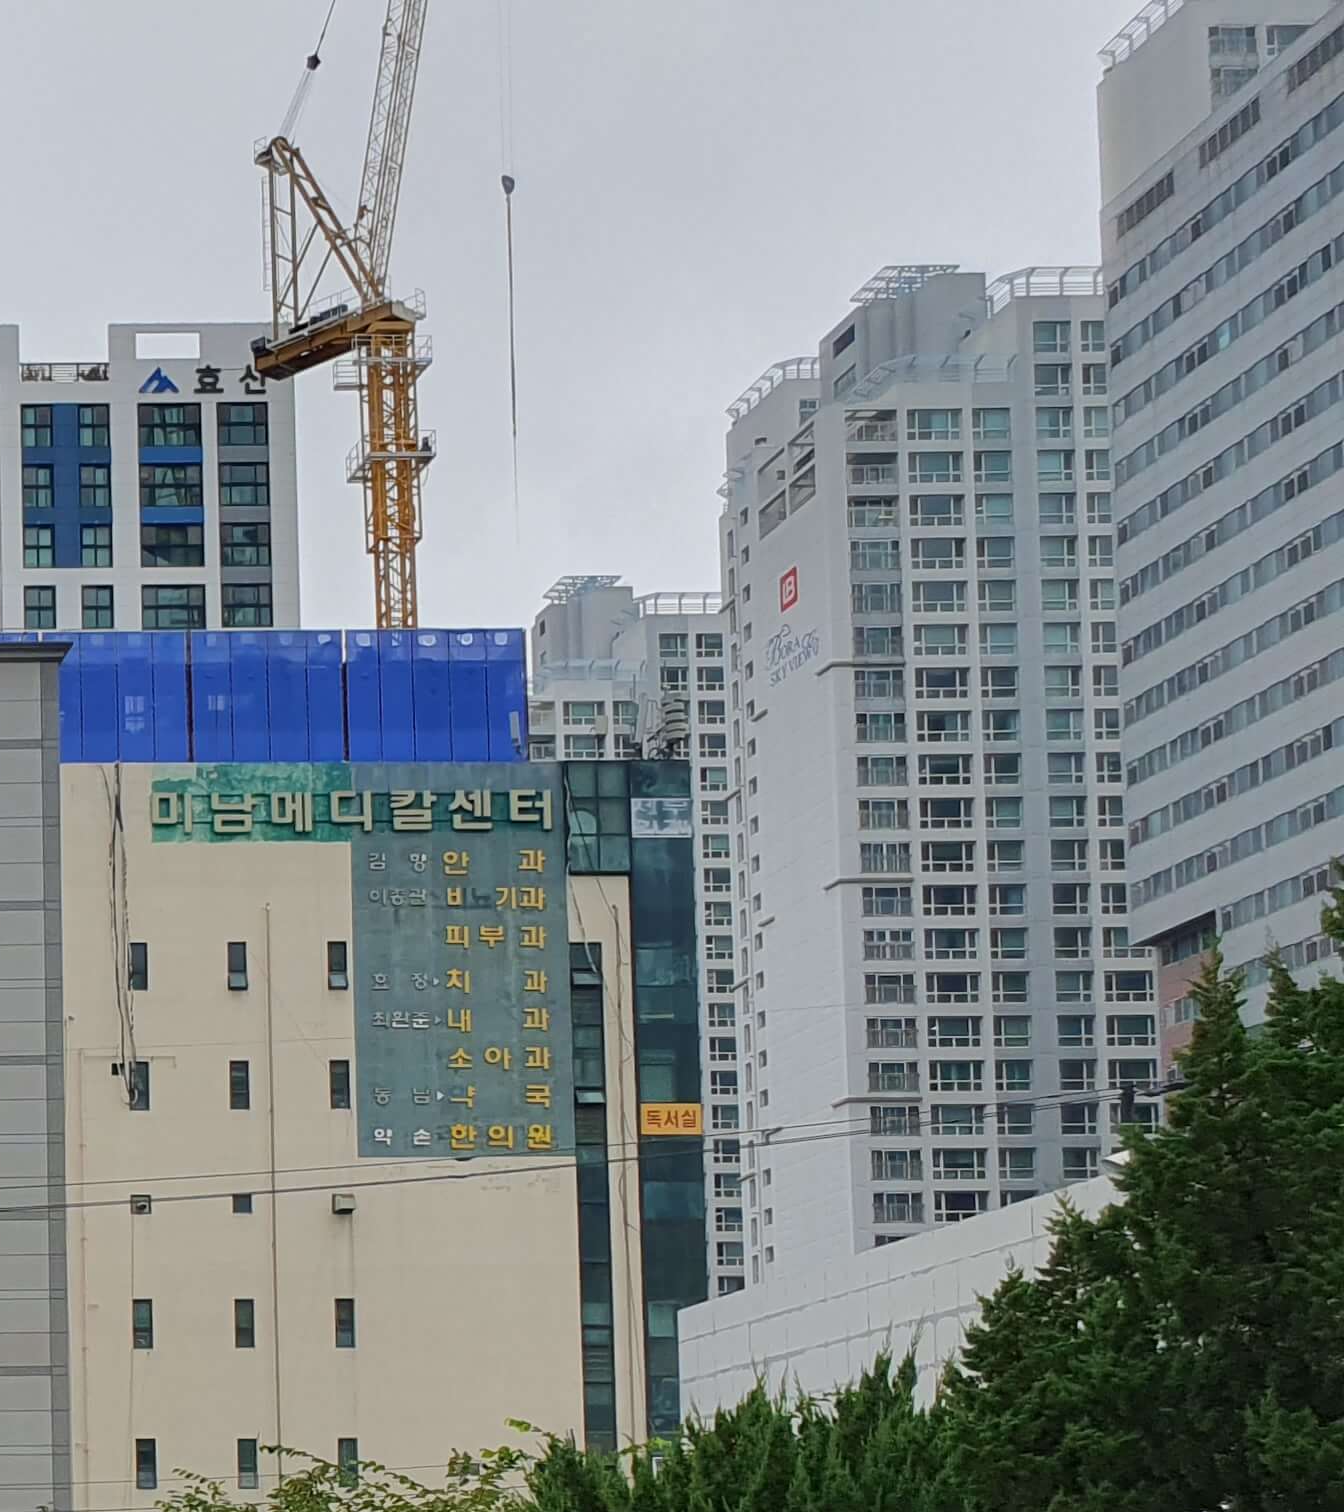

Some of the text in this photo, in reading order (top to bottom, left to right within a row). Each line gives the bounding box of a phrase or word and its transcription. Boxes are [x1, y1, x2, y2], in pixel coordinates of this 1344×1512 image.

[151, 789, 554, 834] 미남메디칼센터
[444, 925, 547, 950] 피부과
[447, 1047, 552, 1071] 소아과
[647, 1110, 696, 1128] 독서실
[450, 1123, 553, 1150] 한의원
